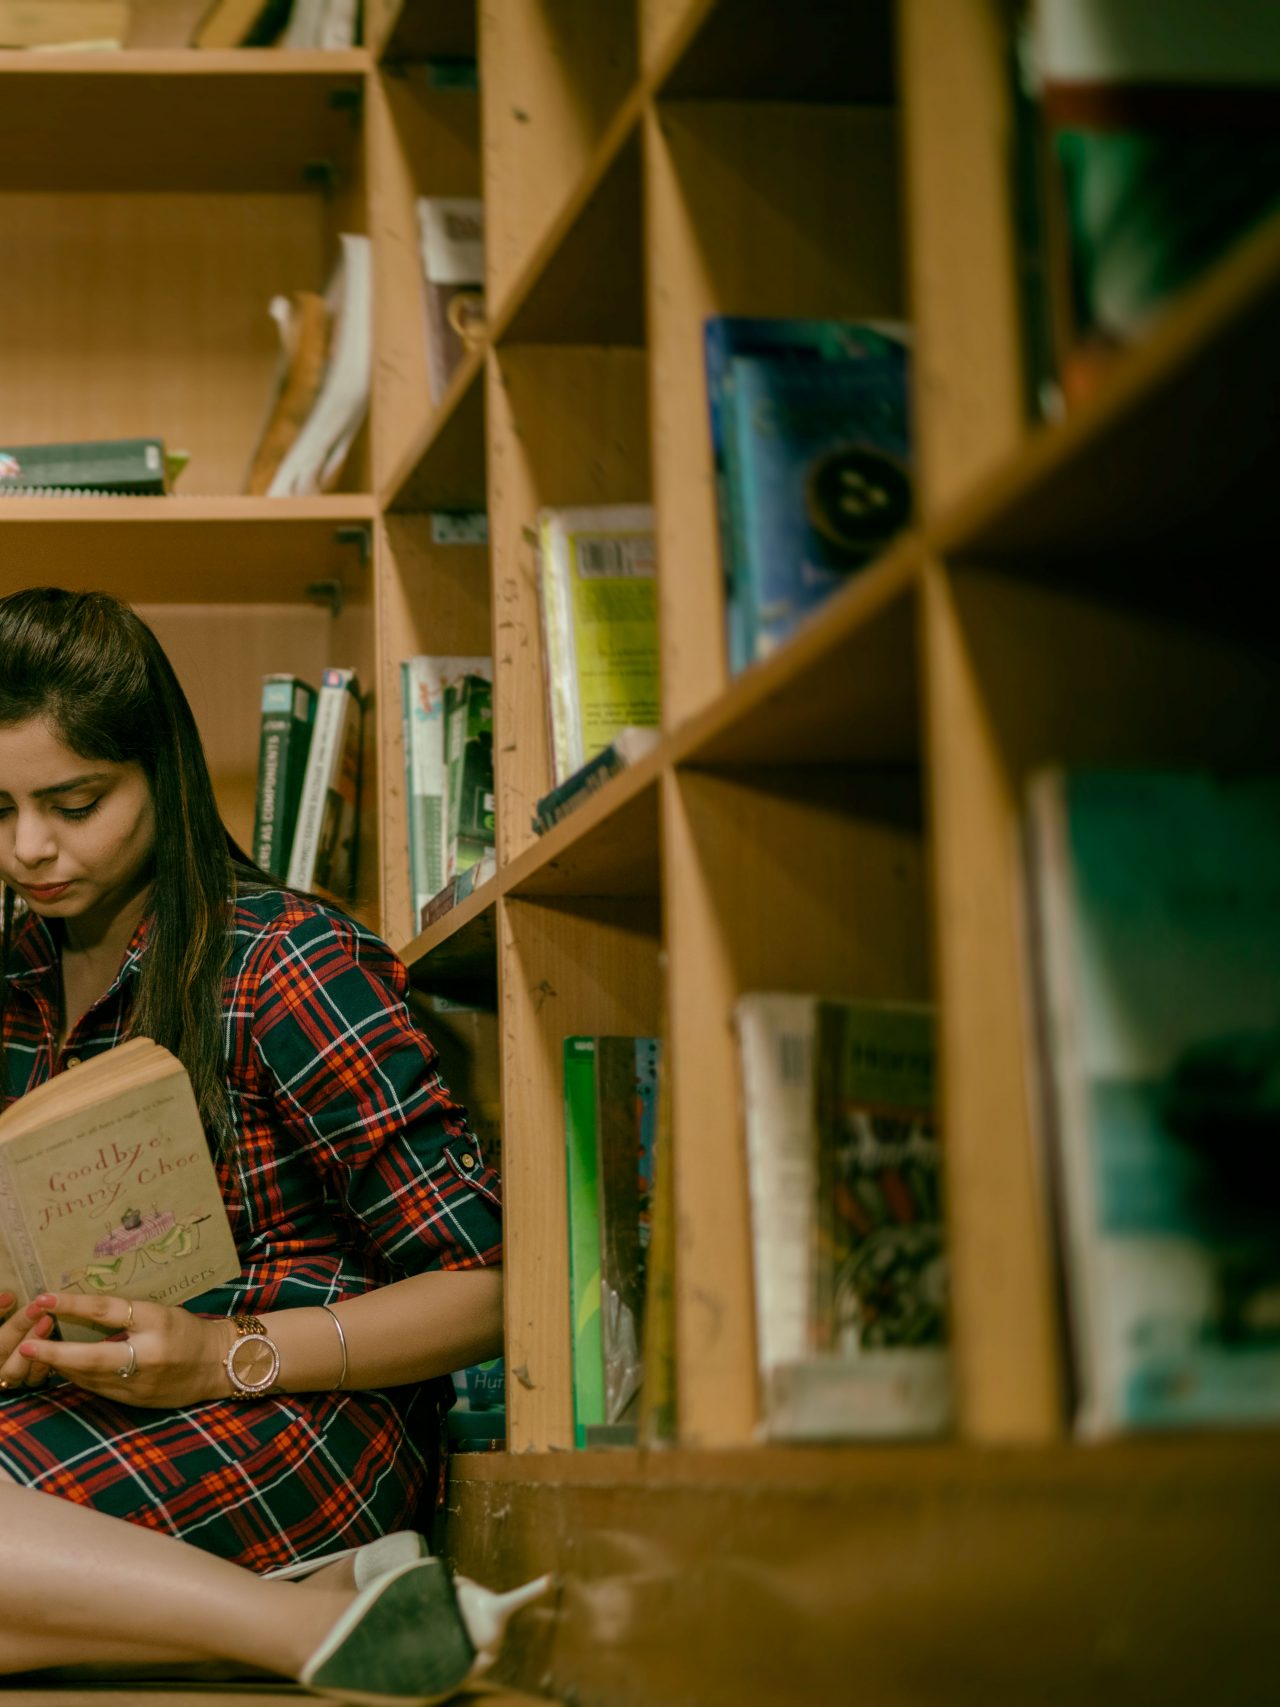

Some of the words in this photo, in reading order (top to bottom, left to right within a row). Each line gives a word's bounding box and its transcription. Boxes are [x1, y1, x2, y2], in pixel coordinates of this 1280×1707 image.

[37, 1182, 126, 1231] Jimmy
[138, 1152, 200, 1185] Choo
[148, 1268, 216, 1301] Sanders
